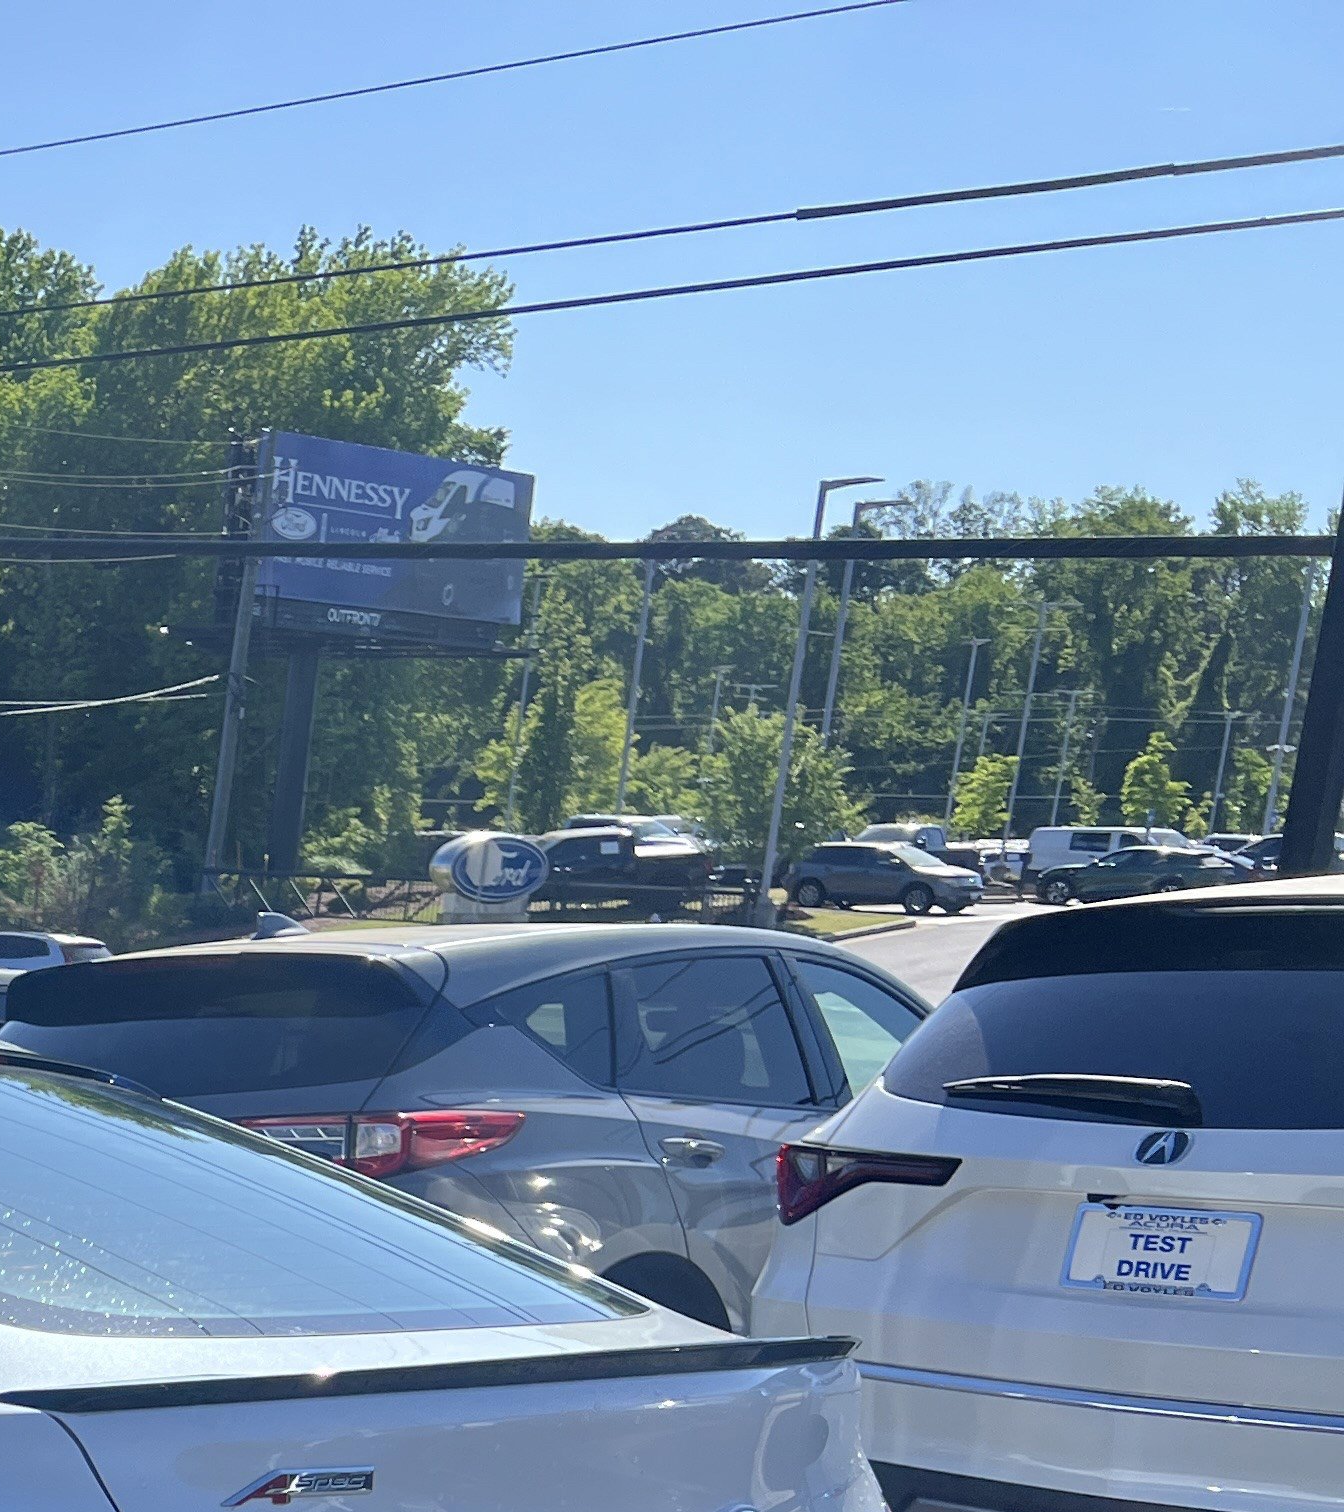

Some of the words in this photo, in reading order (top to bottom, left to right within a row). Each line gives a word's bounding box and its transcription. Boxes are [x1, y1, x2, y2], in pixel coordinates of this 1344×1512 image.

[271, 455, 411, 520] HENNESSY
[1128, 1220, 1200, 1231] ACURA
[1129, 1233, 1193, 1254] TEST
[1116, 1259, 1192, 1281] DRIVE
